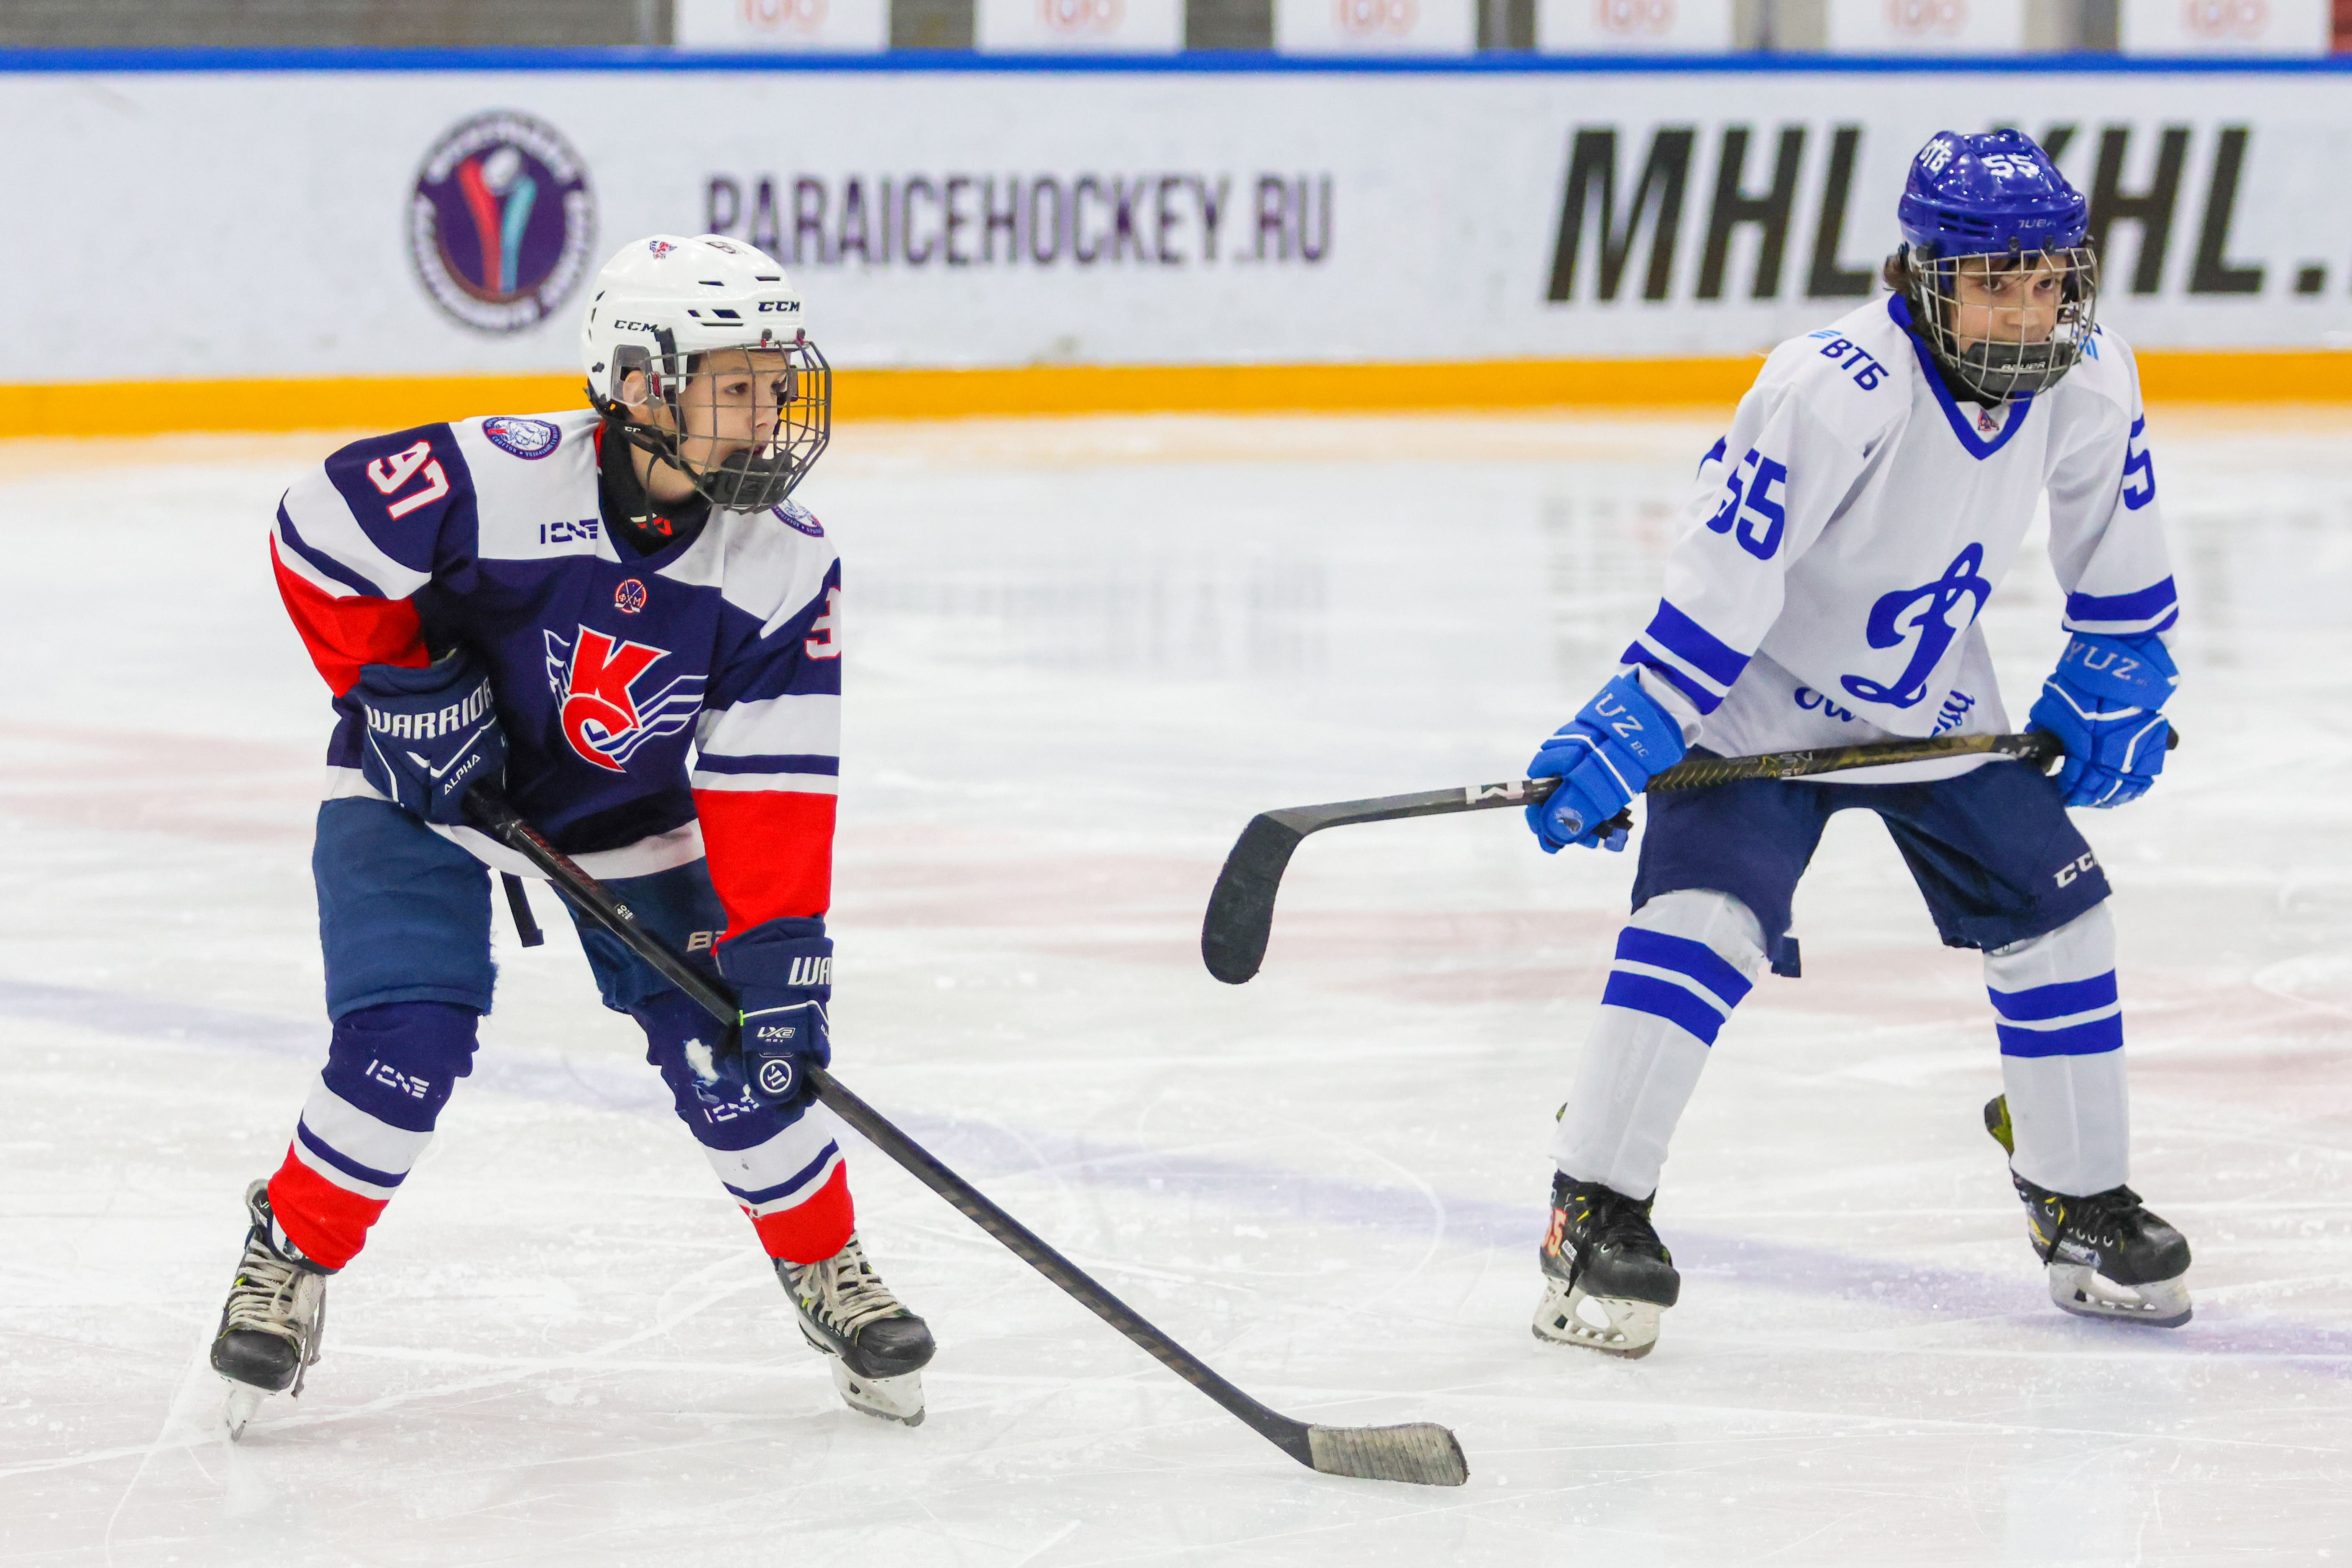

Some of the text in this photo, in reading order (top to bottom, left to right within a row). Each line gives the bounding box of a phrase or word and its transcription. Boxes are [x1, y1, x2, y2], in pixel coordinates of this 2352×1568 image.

[1981, 154, 2040, 178] 55
[705, 174, 1334, 269] PARAICEHOCKEY.RU
[614, 320, 658, 333] CCM
[758, 301, 801, 312] CCM
[1820, 338, 1890, 391] ВТБ
[366, 440, 451, 521] 97
[365, 675, 494, 739] WARRIOR
[1594, 690, 1644, 738] UZ
[444, 753, 481, 796] ALPHA
[2053, 851, 2099, 888] CC
[617, 905, 627, 915] 40
